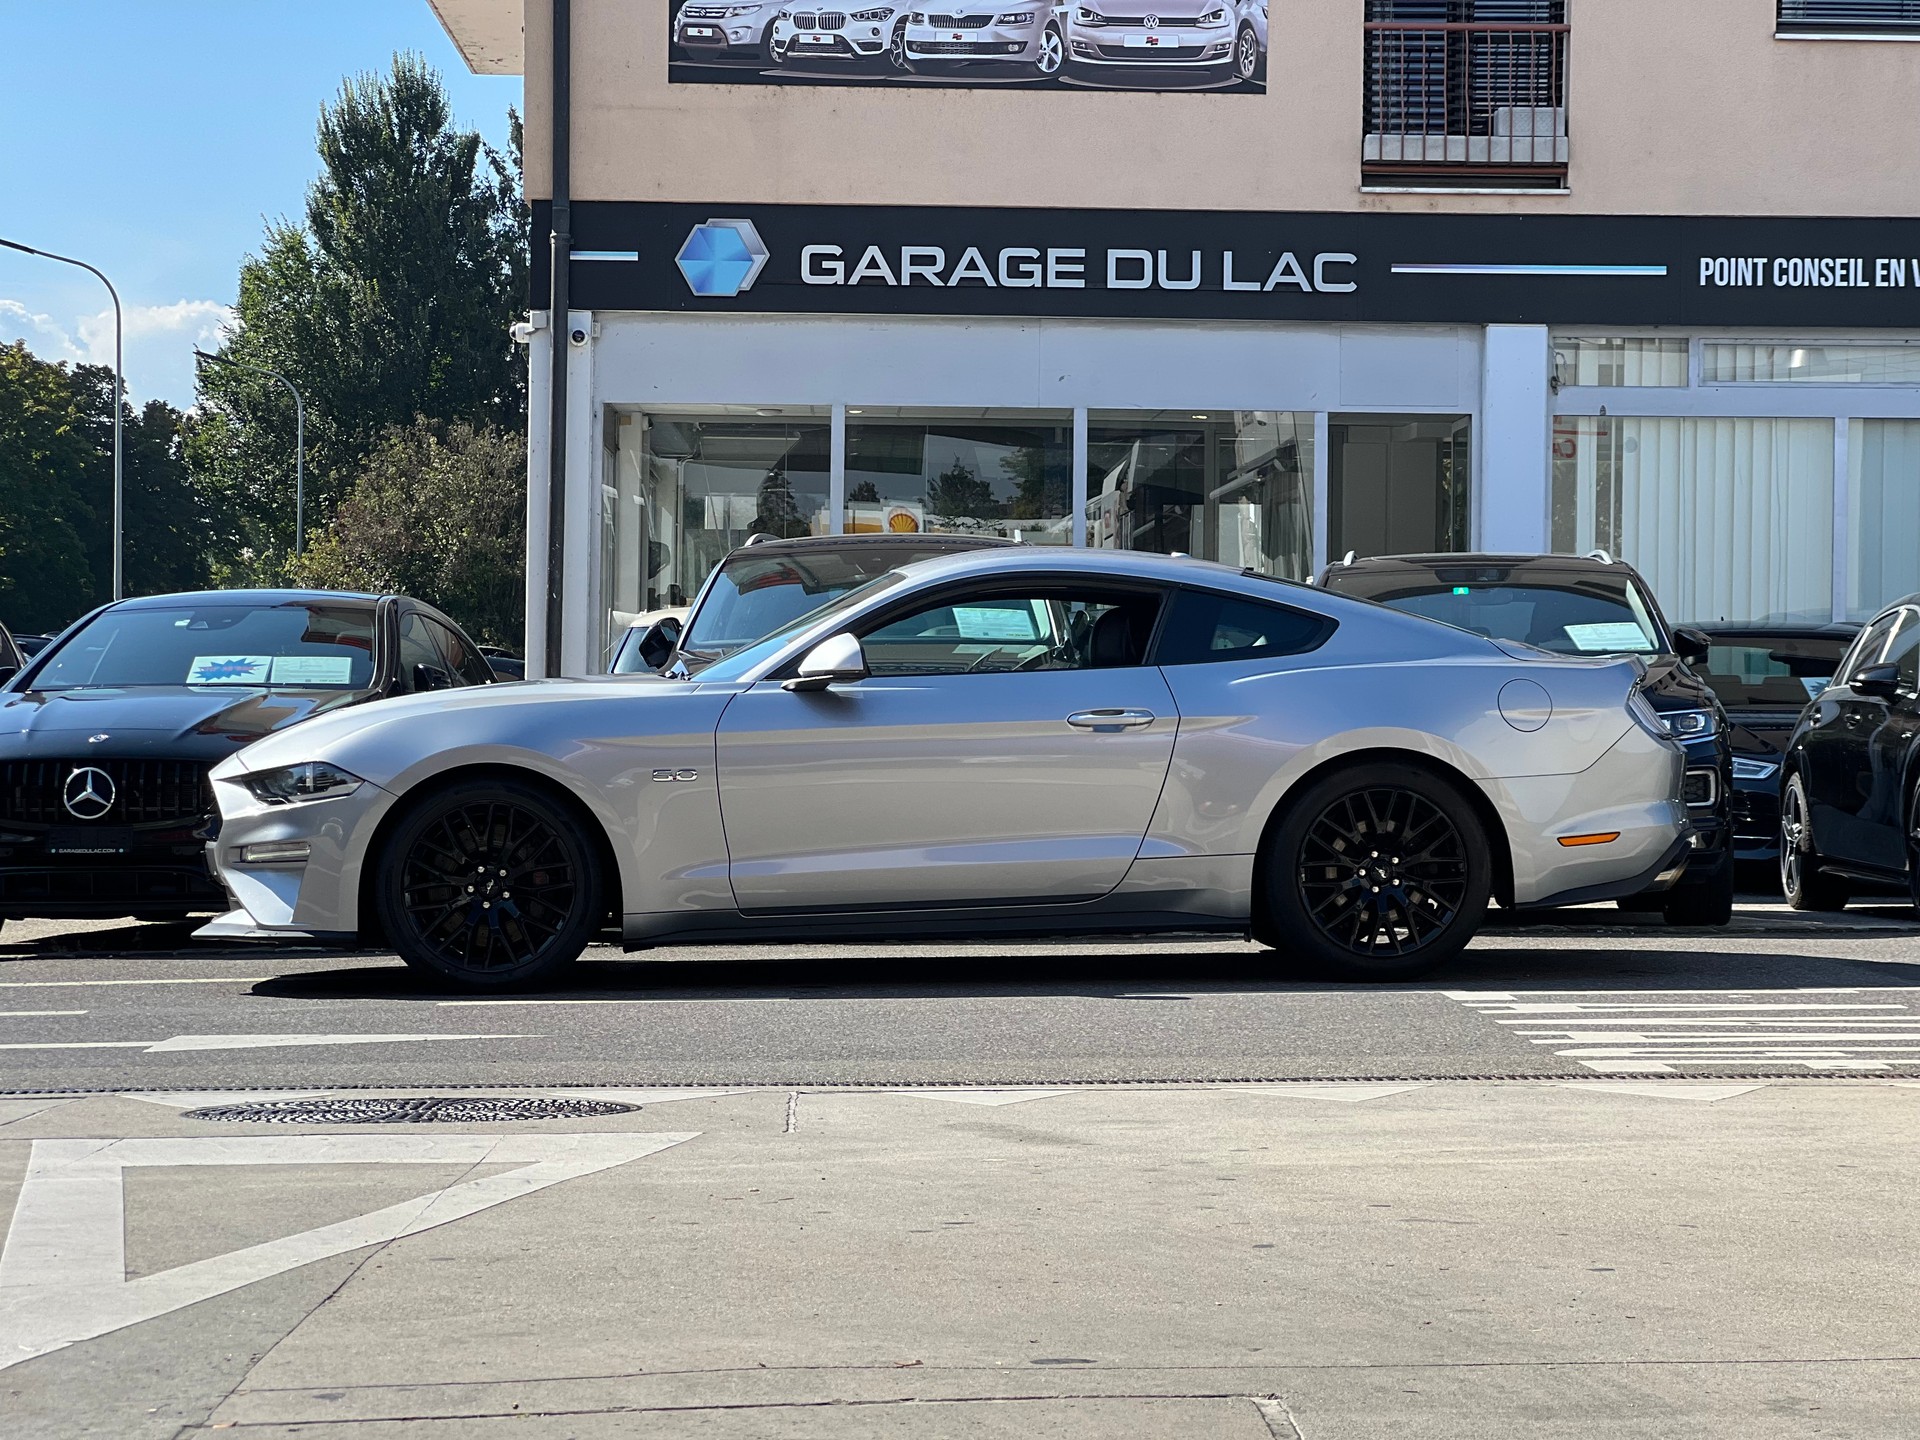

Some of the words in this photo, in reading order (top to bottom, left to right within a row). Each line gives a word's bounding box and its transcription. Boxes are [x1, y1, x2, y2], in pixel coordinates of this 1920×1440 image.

[799, 244, 1086, 289] GARAGE
[1105, 248, 1202, 291] DU
[1221, 250, 1358, 294] LAC
[1699, 256, 1768, 287] POINT
[1772, 257, 1870, 288] CONSEIL
[1874, 257, 1906, 288] EN
[652, 768, 698, 783] 5.0
